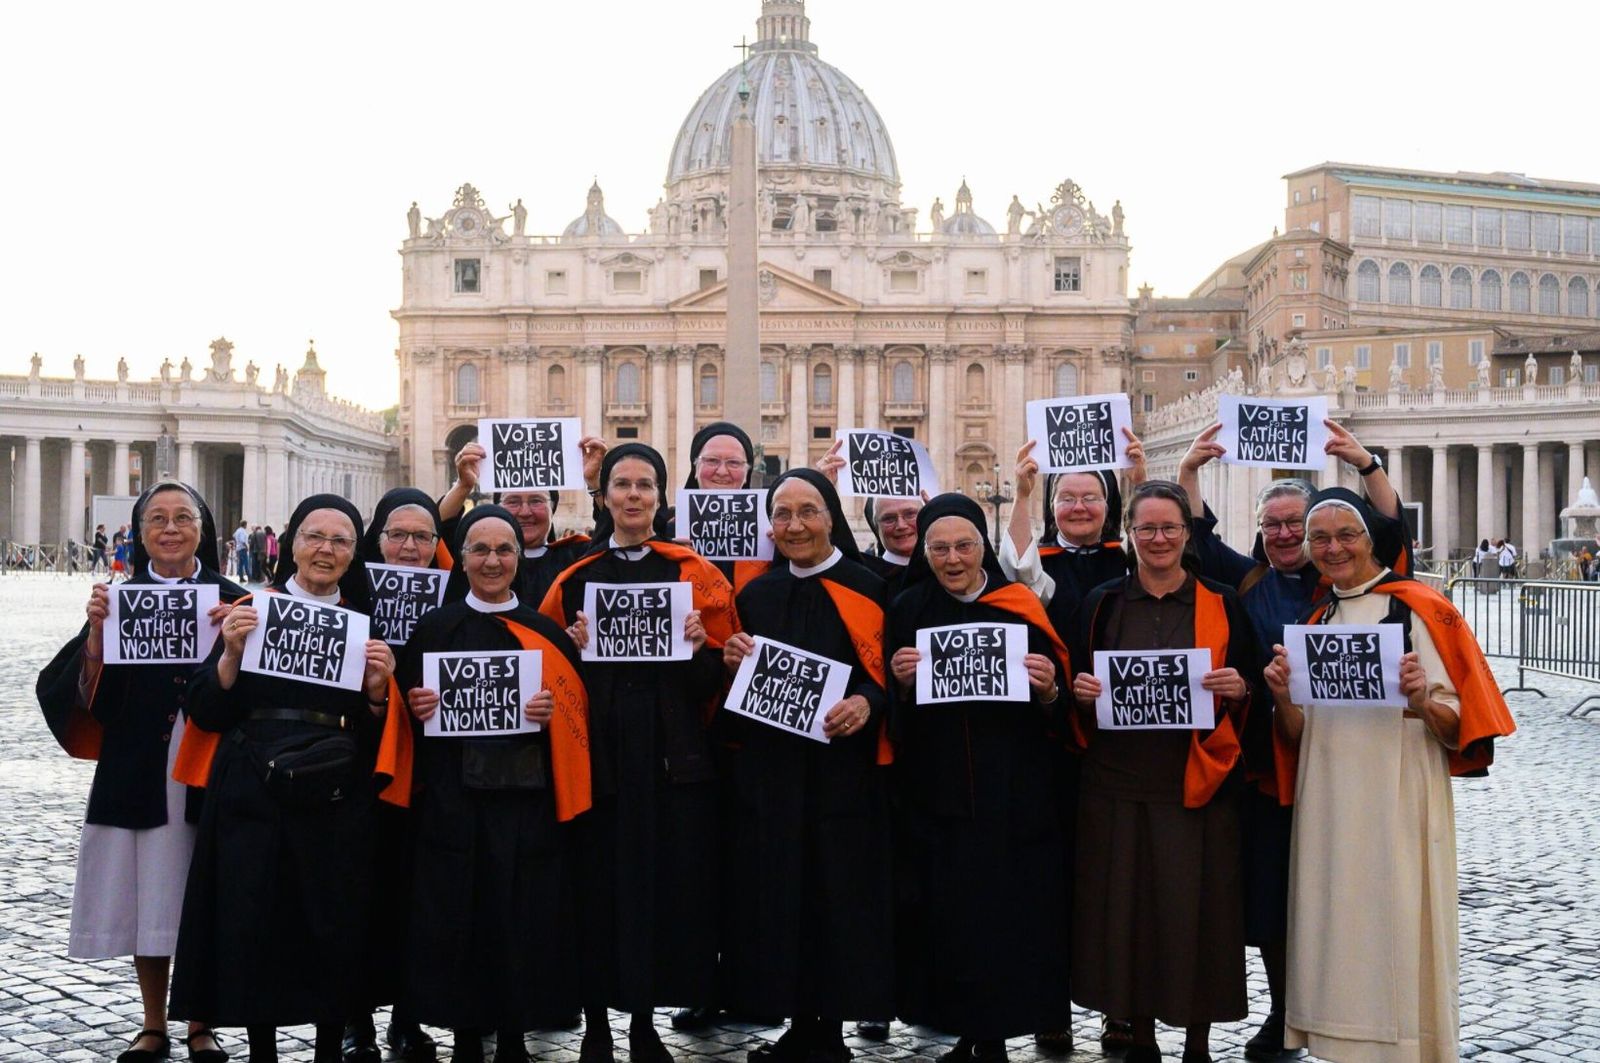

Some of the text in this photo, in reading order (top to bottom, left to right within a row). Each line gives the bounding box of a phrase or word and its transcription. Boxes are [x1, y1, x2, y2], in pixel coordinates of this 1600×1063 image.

[509, 321, 521, 330] IN
[528, 321, 582, 331] HONOREM
[885, 320, 909, 329] MAX
[1073, 422, 1093, 432] for
[1265, 420, 1286, 428] for
[1050, 428, 1111, 448] CATHOLIC
[1240, 426, 1305, 443] CATHOLIC
[520, 440, 542, 451] for
[1240, 442, 1303, 463] WOMEN
[495, 450, 560, 467] CATHOLIC
[877, 451, 897, 461] for
[1051, 444, 1112, 467] WOMEN
[496, 467, 561, 487] WOMEN
[852, 460, 915, 476] CATHOLIC
[853, 477, 916, 496] WOMEN
[716, 512, 737, 522] for
[691, 521, 755, 537] CATHOLIC
[692, 538, 755, 556] WOMEN
[393, 591, 416, 600] for
[150, 610, 174, 620] for
[370, 598, 435, 619] ATHOLI
[626, 608, 649, 618] for
[121, 619, 195, 637] CATHOLIC
[298, 622, 323, 633] for
[598, 617, 669, 635] CATHOLIC
[122, 638, 194, 659] WOMEN
[266, 627, 344, 657] CATHOLIC
[599, 635, 669, 656] WOMEN
[960, 647, 983, 657] for
[1336, 653, 1358, 663] for
[265, 648, 339, 681] WOMEN
[934, 656, 1004, 677] CATHOLIC
[1310, 662, 1379, 679] CATHOLIC
[471, 678, 496, 689] for
[781, 672, 803, 684] for
[934, 675, 1004, 698] WOMEN
[1141, 676, 1165, 686] for
[442, 687, 517, 708] CATHOLIC
[752, 674, 819, 709] CATHOLIC
[1113, 685, 1187, 704] CATHOLIC
[1312, 681, 1381, 699] WOMEN
[443, 707, 516, 731] WOMEN
[746, 691, 813, 731] WOMEN
[1115, 703, 1188, 725] WOMEN
